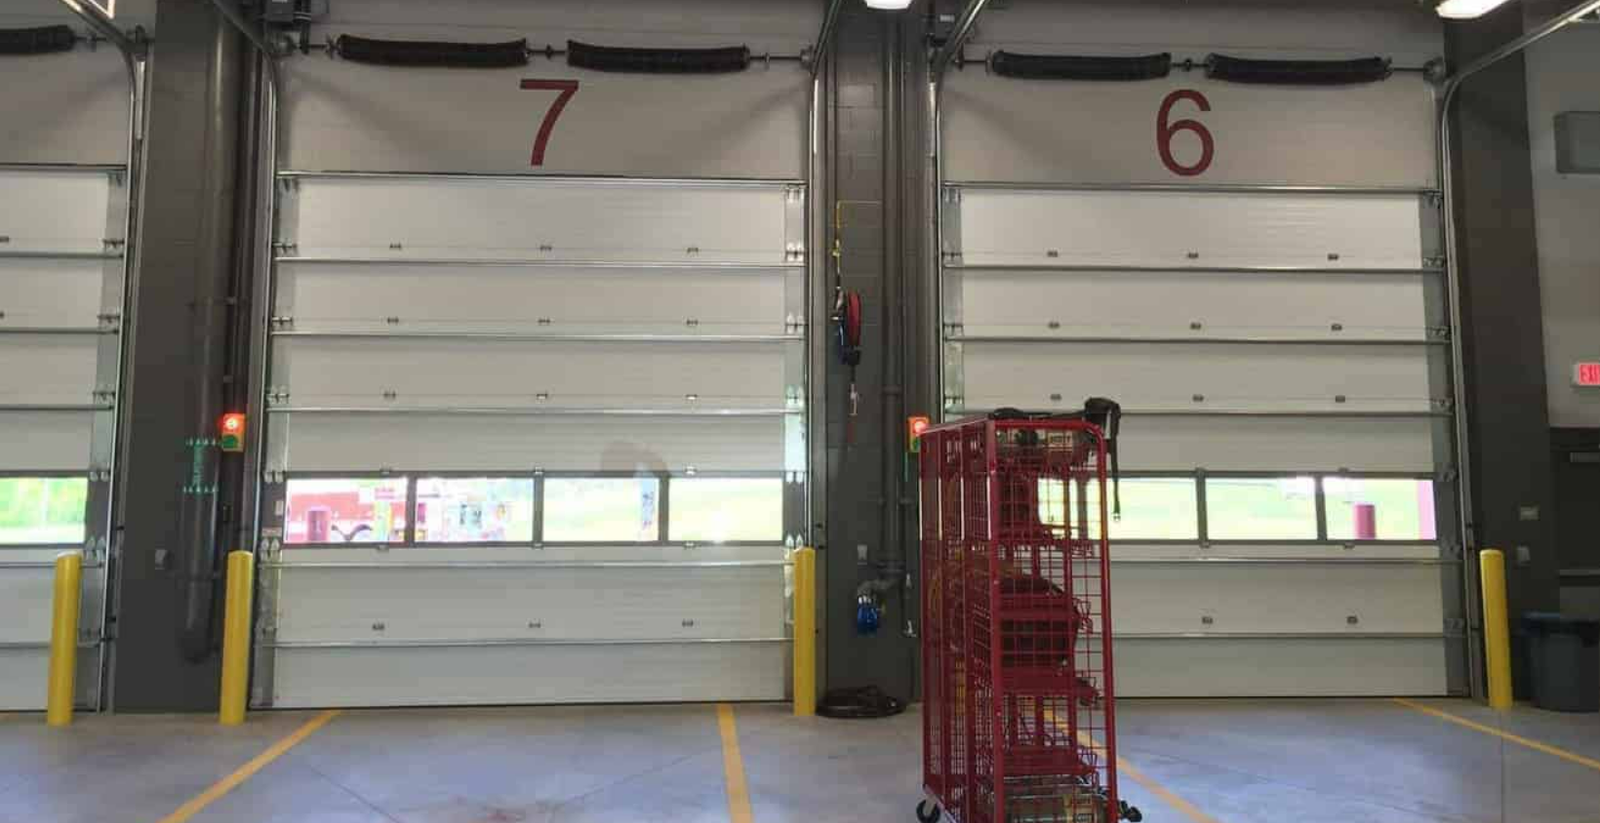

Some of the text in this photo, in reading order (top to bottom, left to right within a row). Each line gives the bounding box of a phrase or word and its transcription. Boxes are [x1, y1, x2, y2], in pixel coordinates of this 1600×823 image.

[520, 79, 578, 166] 7
[1156, 89, 1214, 176] 6
[1580, 364, 1600, 384] EXI
